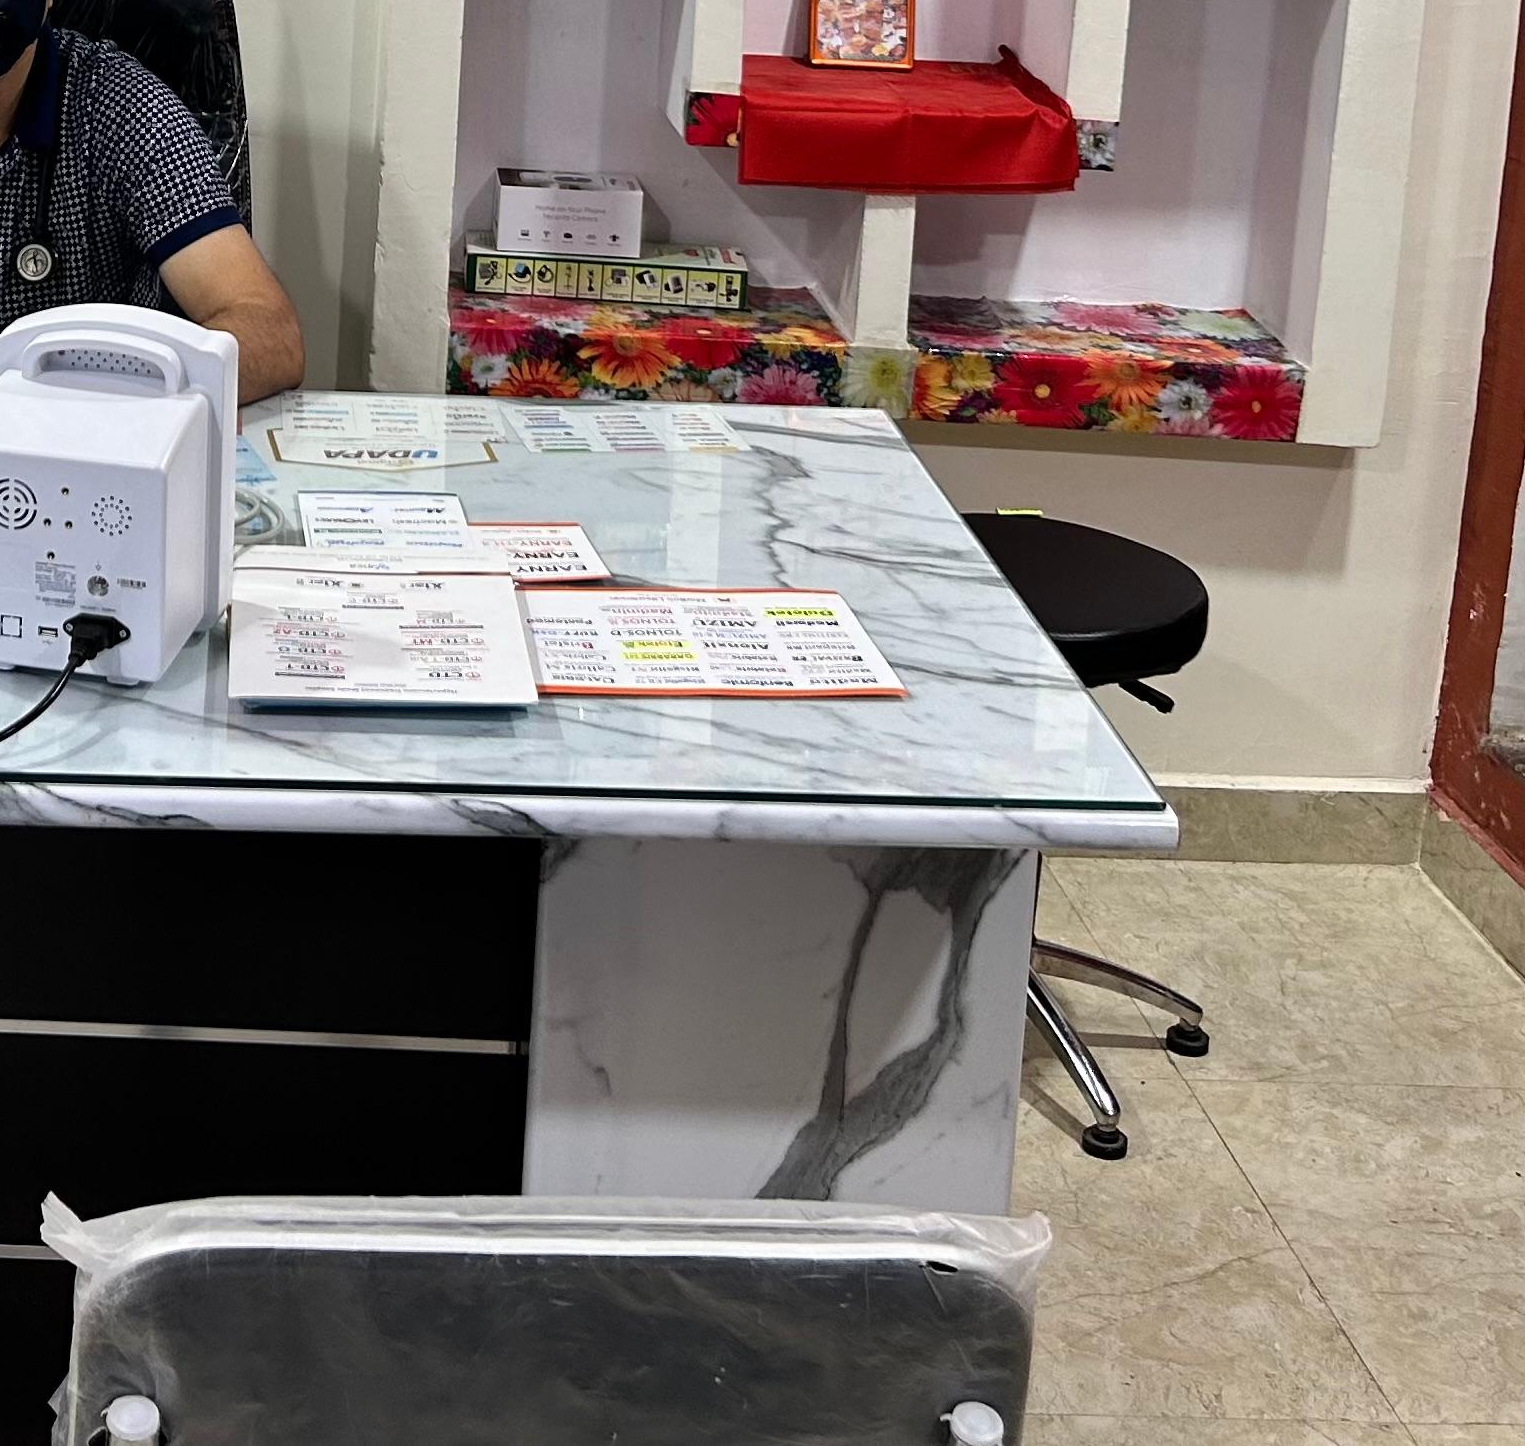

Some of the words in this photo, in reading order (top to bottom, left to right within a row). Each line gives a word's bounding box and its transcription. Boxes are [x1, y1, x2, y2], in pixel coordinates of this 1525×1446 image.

[323, 449, 439, 459] UDAPA
[516, 564, 588, 573] EARNY
[691, 619, 757, 627] AMIZU
